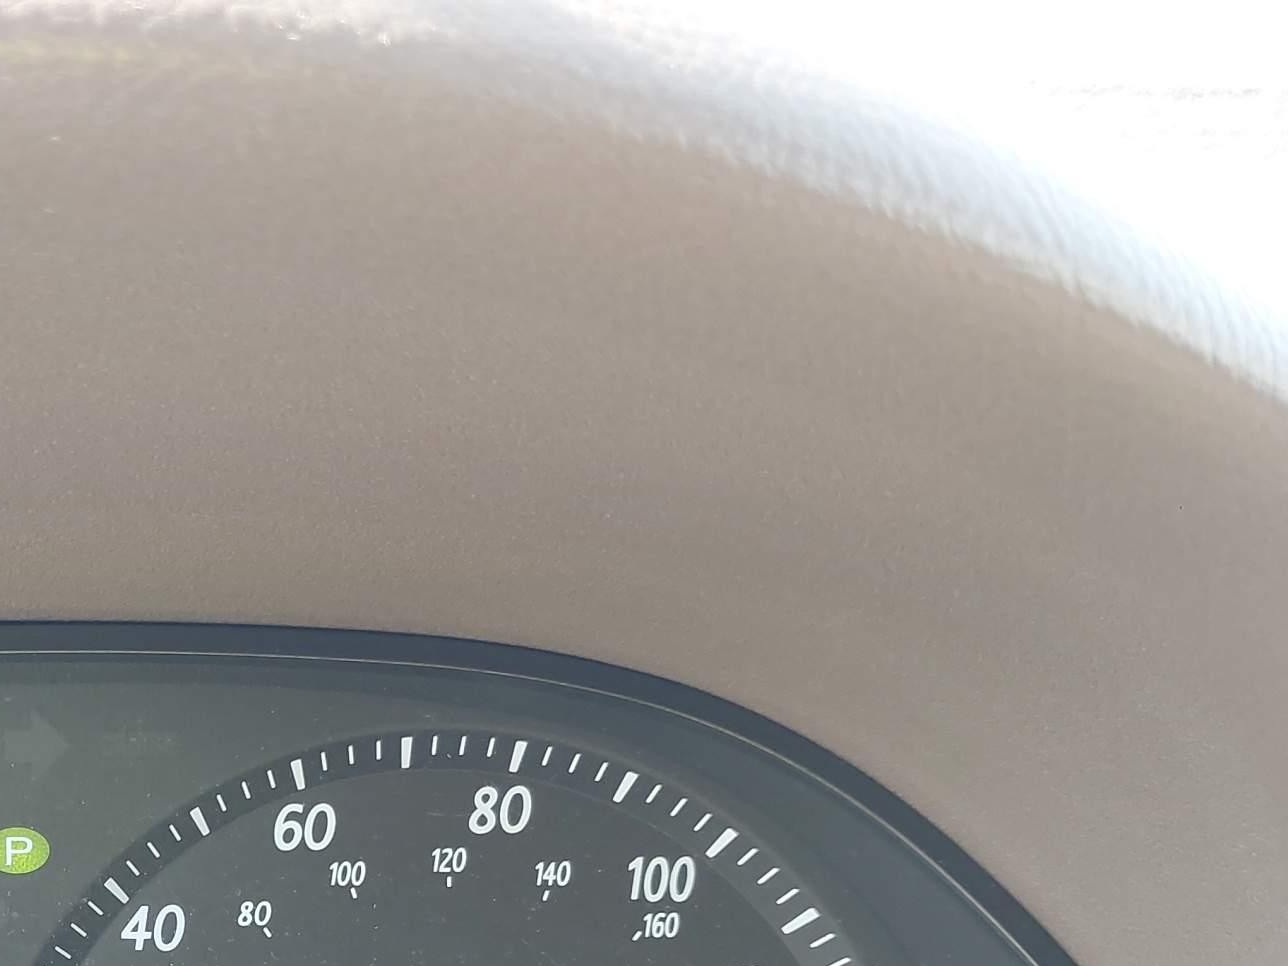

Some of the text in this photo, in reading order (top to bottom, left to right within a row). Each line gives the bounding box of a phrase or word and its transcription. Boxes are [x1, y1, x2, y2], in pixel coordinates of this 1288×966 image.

[468, 785, 533, 835] 80
[273, 803, 337, 852] 60
[4, 837, 34, 866] P
[431, 847, 467, 874] 120
[328, 861, 366, 887] 100
[534, 860, 572, 887] 140
[627, 856, 695, 902] 100
[120, 903, 186, 952] 40
[236, 901, 273, 927] 80
[642, 912, 680, 938] 160
